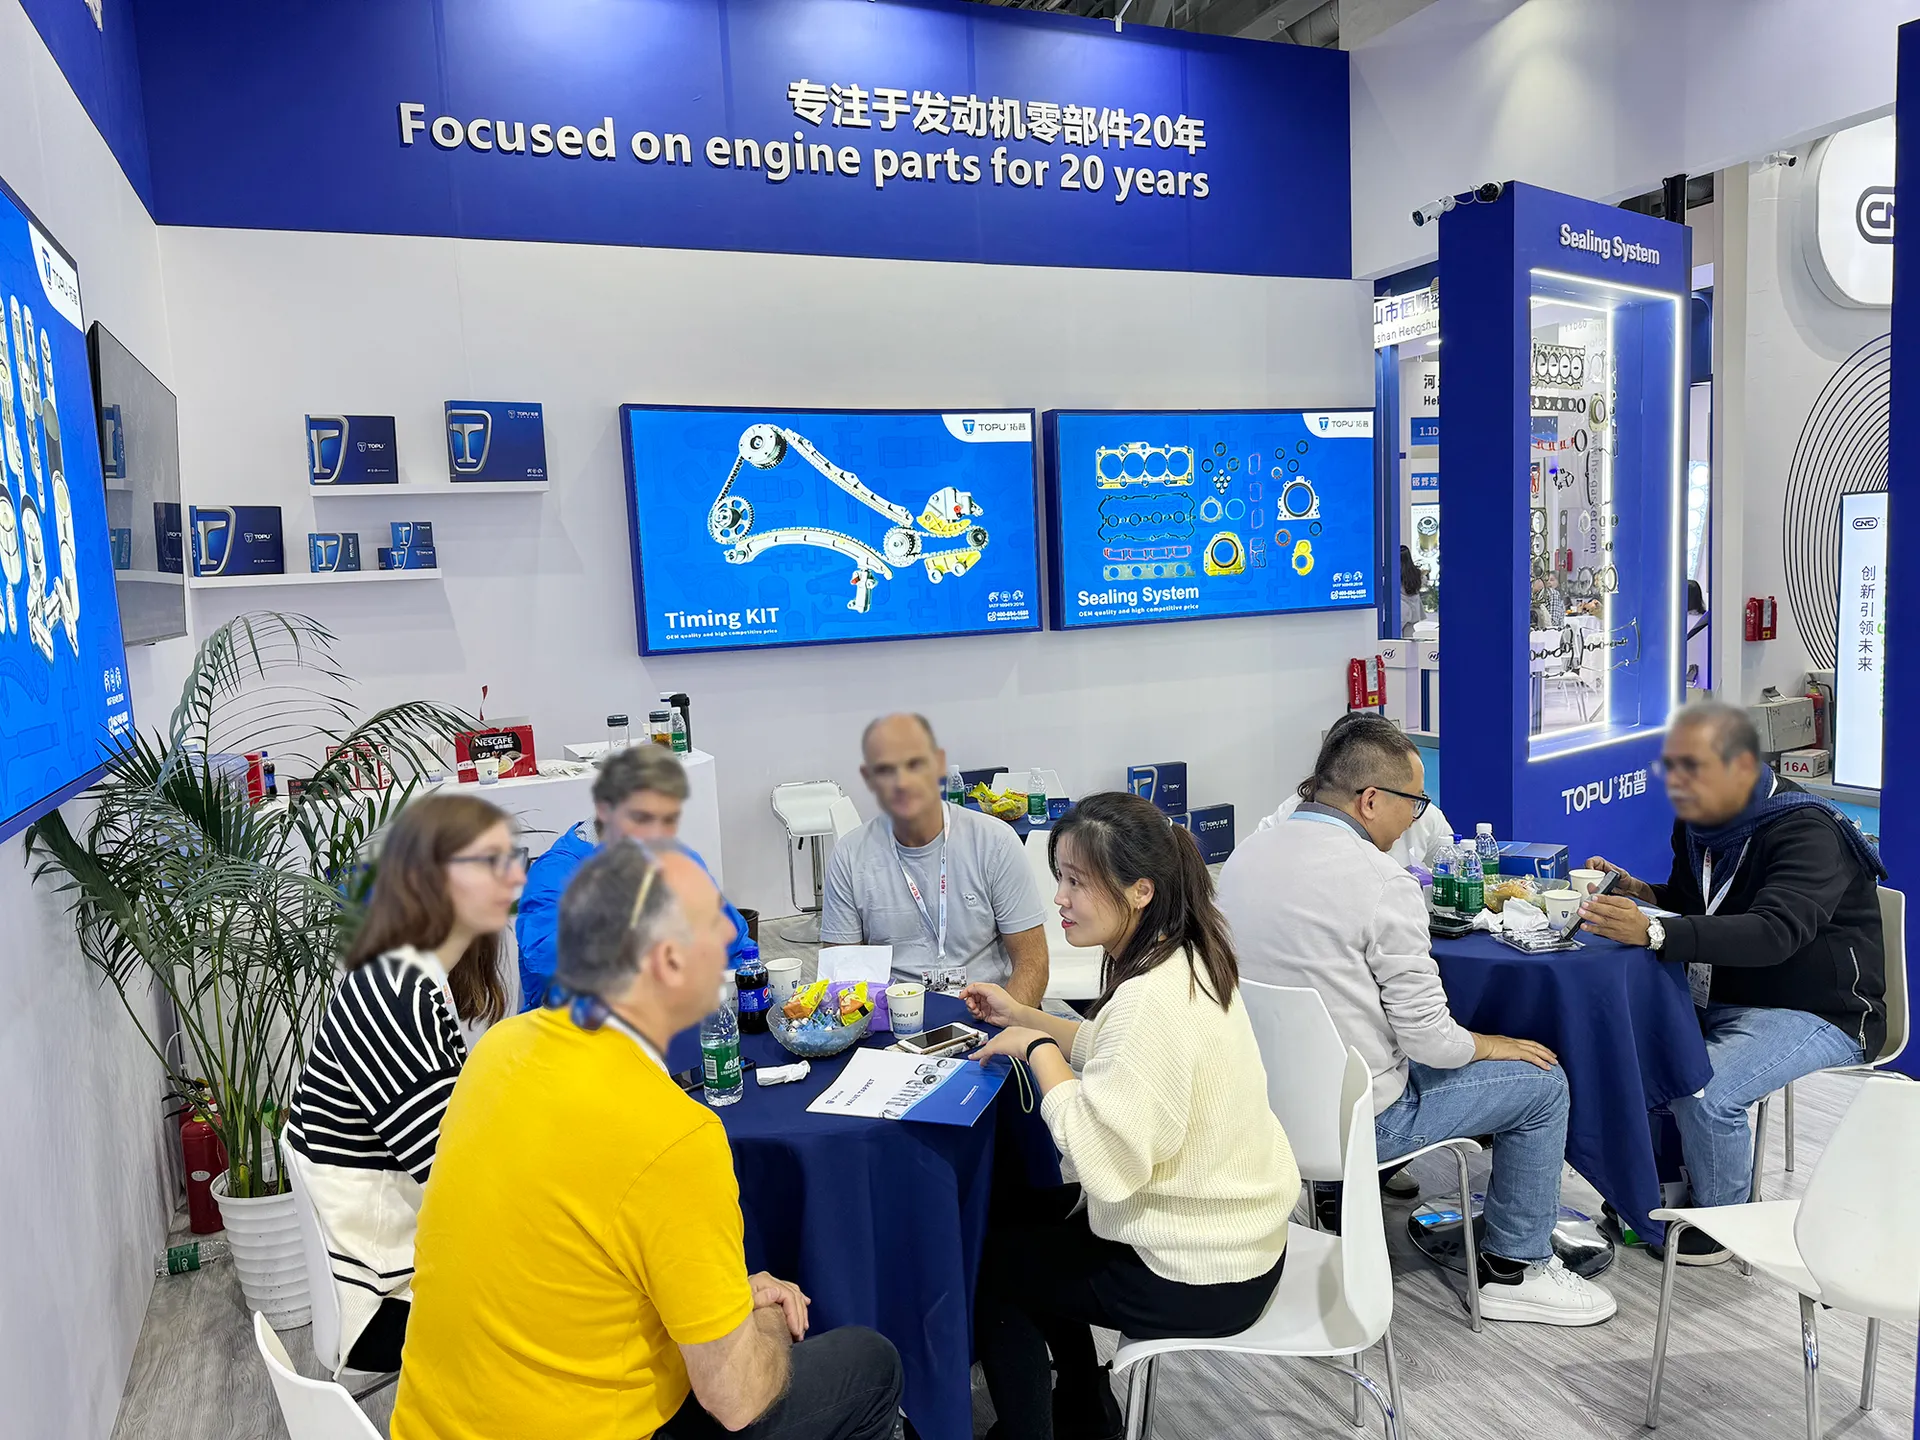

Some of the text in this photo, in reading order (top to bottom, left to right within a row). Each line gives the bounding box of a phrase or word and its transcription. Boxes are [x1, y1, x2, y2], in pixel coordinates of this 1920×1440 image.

[788, 79, 1207, 155] 专注于发动机零部件20年
[399, 102, 1210, 202] Focused on engine parts for 20 years
[1559, 223, 1660, 265] Sealing System
[978, 423, 1006, 431] TOPU
[1331, 420, 1353, 428] TOPU
[1077, 585, 1200, 607] Sealing System
[664, 607, 780, 630] Timing KIT
[1094, 609, 1117, 617] quality
[1131, 606, 1145, 614] high
[1146, 604, 1182, 613] competitive
[1857, 565, 1876, 672] 创新引领未来
[680, 632, 702, 640] quality
[1783, 761, 1810, 773] 16A
[1618, 768, 1647, 800] 拓普
